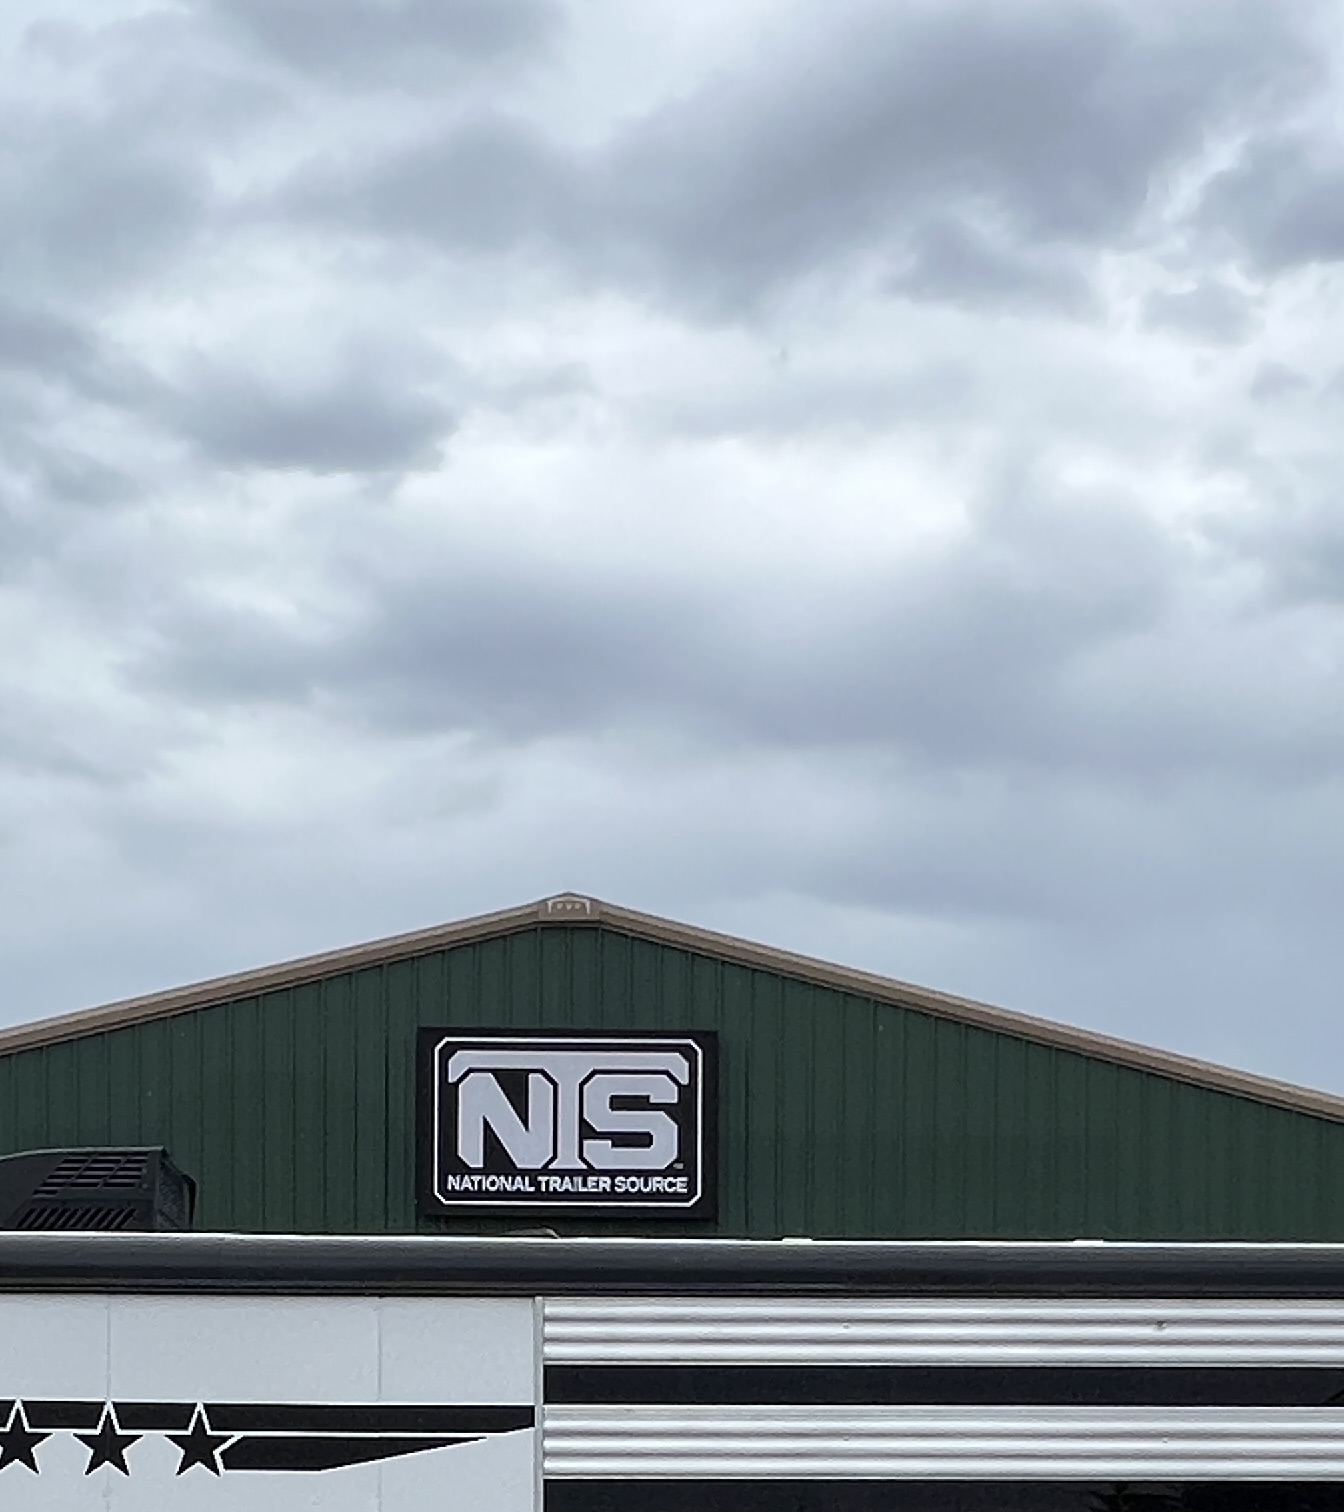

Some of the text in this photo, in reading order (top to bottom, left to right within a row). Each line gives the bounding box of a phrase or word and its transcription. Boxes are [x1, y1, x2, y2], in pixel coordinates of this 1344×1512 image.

[448, 1050, 690, 1170] NTS
[447, 1174, 689, 1194] NATIONAL TRAILER SOURCE
